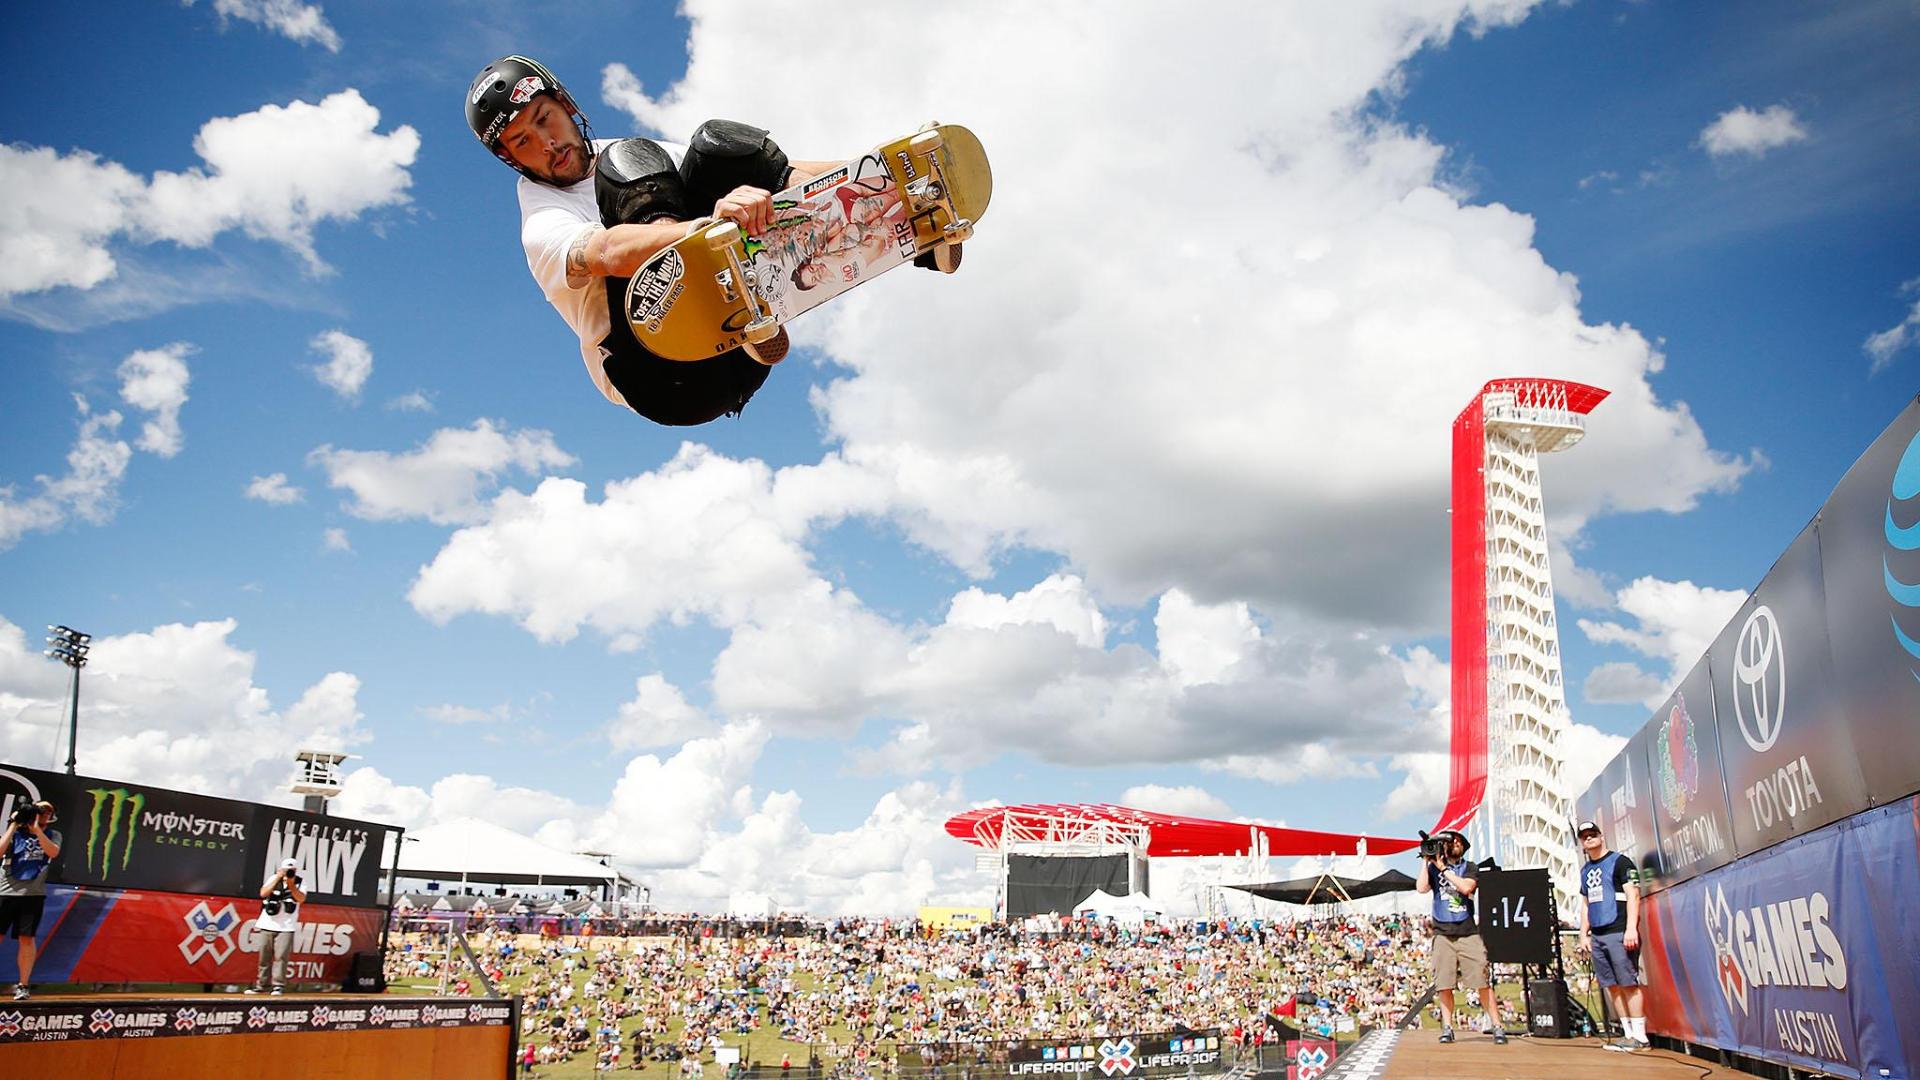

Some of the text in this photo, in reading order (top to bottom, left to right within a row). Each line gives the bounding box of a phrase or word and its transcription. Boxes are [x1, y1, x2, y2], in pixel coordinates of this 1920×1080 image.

[633, 269, 656, 297] VANS
[645, 277, 669, 301] THE
[1745, 755, 1823, 831] TOYOTA
[142, 811, 246, 840] MONSTER
[155, 835, 229, 850] ENERGY
[263, 828, 366, 896] NAVY
[238, 918, 354, 956] GMES
[1736, 892, 1847, 990] GAMES
[114, 1012, 167, 1028] GAMES
[196, 1011, 243, 1026] GAMES
[266, 1010, 308, 1024] GAMES
[328, 1009, 366, 1022] GAMES
[385, 1008, 419, 1021] GAMES
[435, 1008, 467, 1020] GAMES
[480, 1007, 510, 1018] GAMES
[22, 1014, 84, 1031] GAMES
[204, 1026, 232, 1035] AUSTIN
[33, 1032, 69, 1041] AUSTIN
[122, 1028, 155, 1038] AUSTIN
[1775, 1008, 1848, 1062] AUSTIN
[1009, 1060, 1095, 1076] LIFEPROOF
[1138, 1052, 1220, 1069] LIFEPROOF
